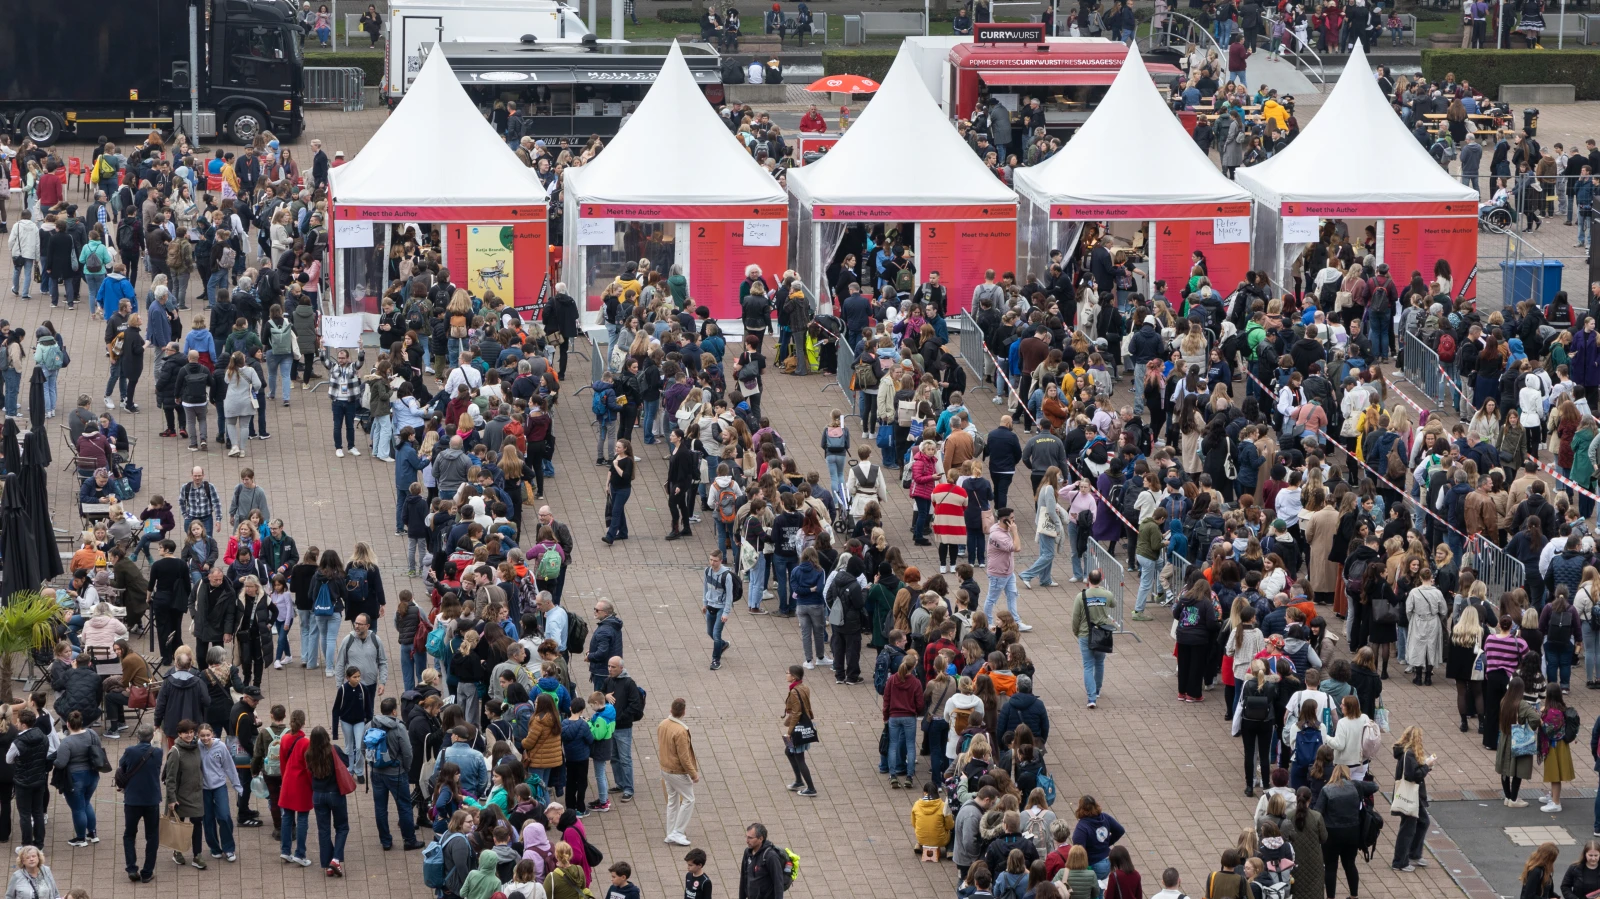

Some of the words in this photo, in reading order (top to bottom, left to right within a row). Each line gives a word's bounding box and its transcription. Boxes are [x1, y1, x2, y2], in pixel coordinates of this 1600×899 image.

[980, 31, 1040, 39] CURRYWURST
[344, 209, 348, 217] 1
[587, 207, 593, 215] 2
[1056, 208, 1063, 216] 4
[455, 229, 461, 239] 1
[698, 227, 705, 238] 2
[928, 228, 936, 238] 3
[1163, 226, 1172, 236] 4
[1392, 224, 1400, 234] 5
